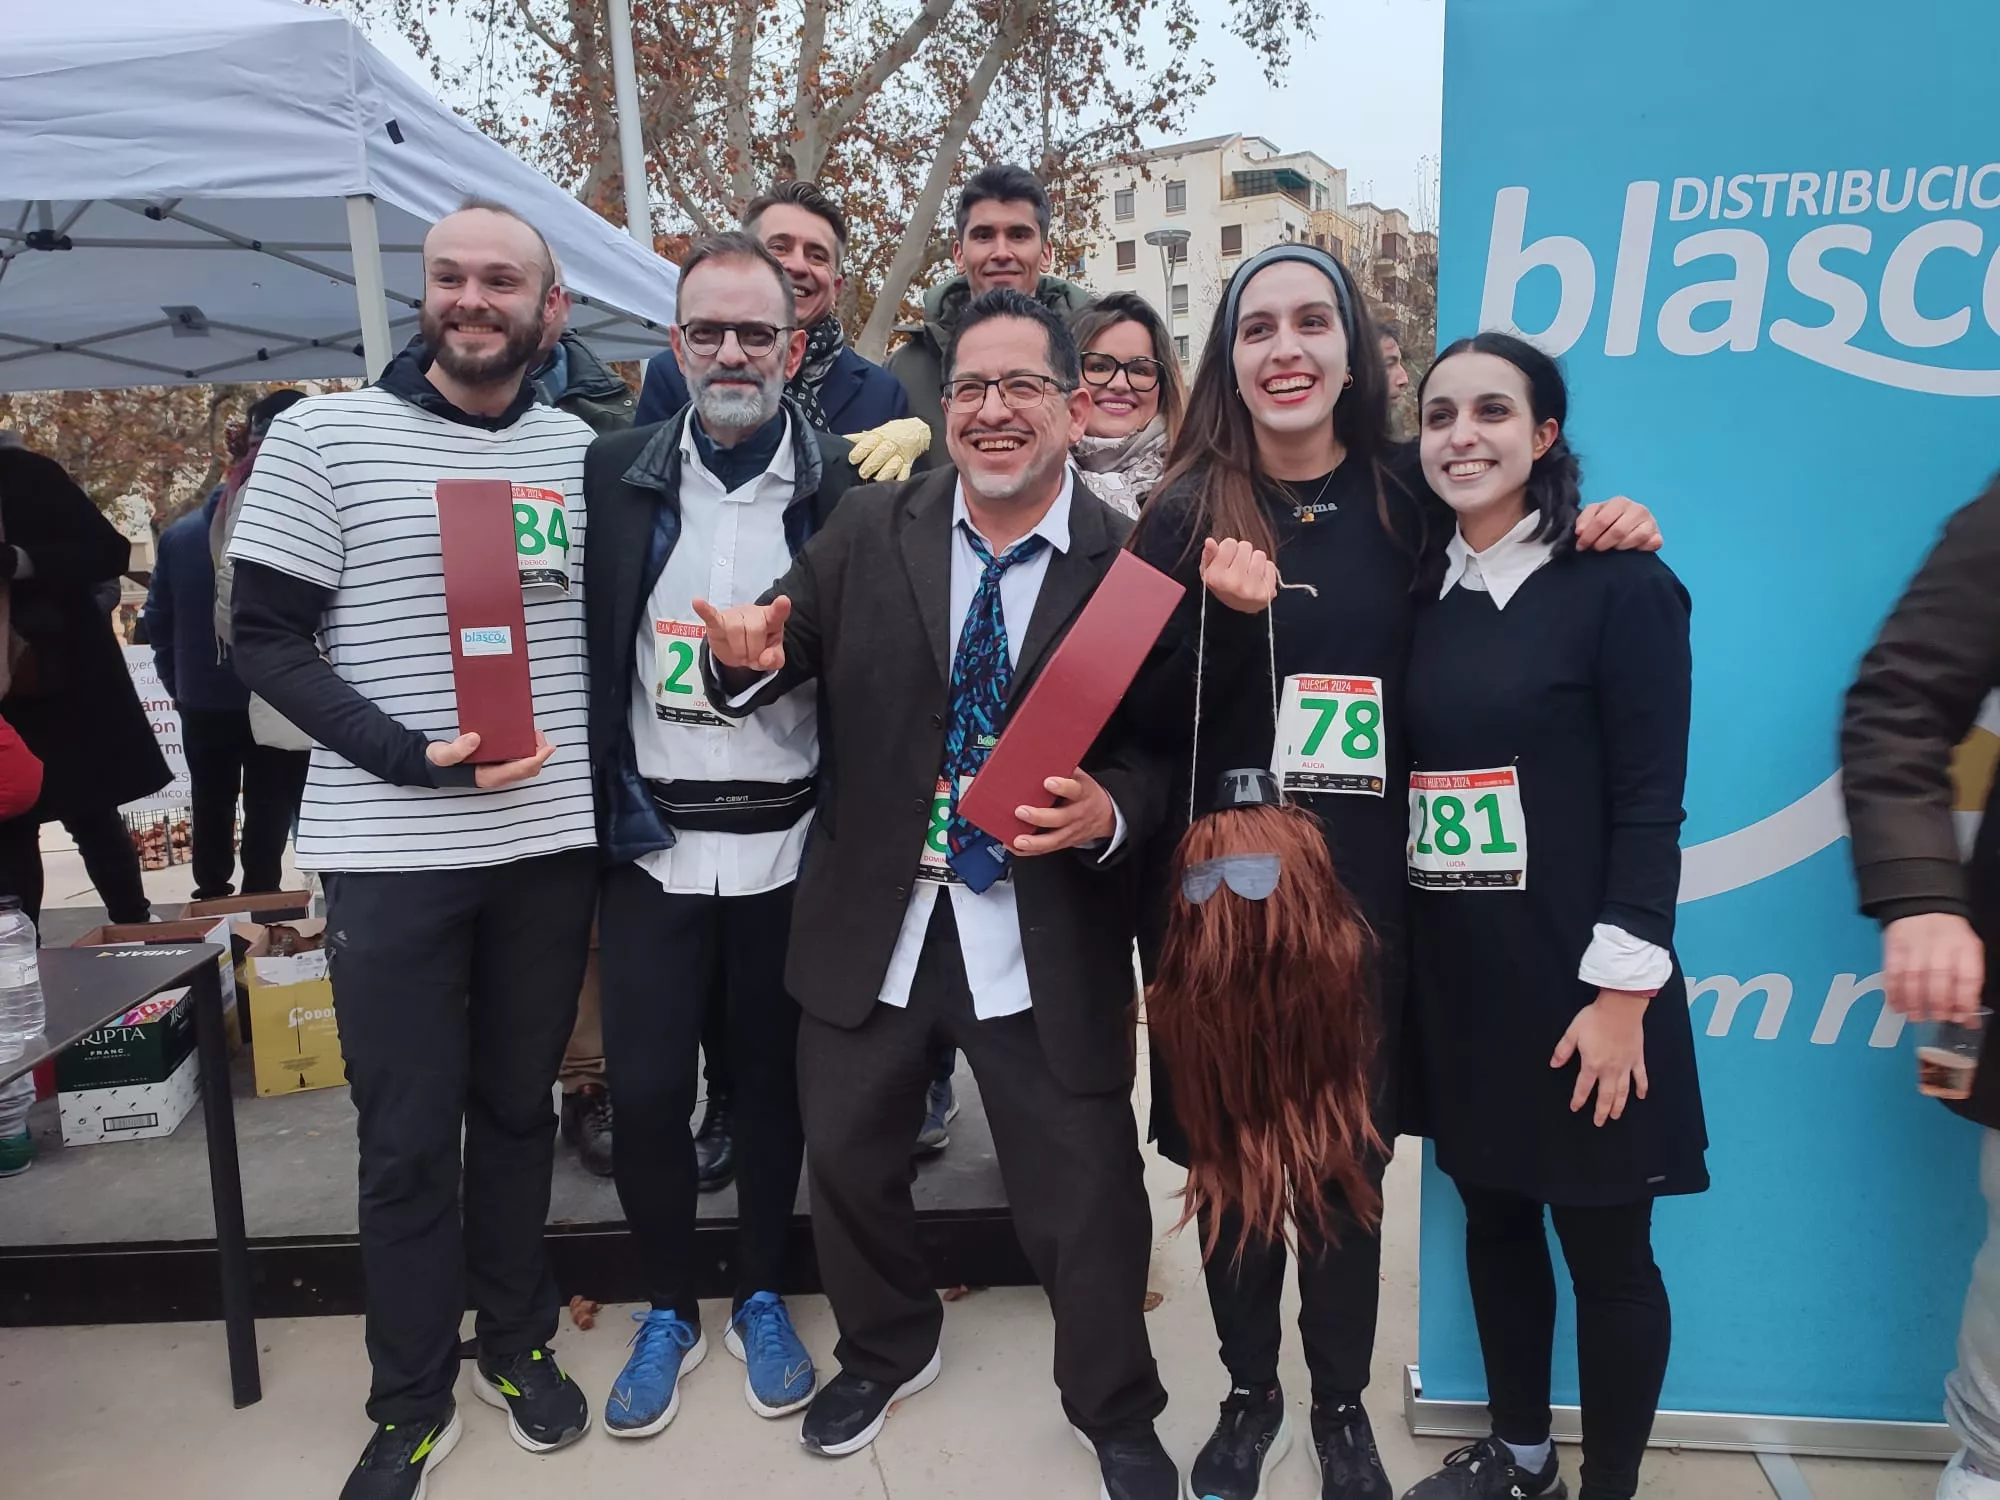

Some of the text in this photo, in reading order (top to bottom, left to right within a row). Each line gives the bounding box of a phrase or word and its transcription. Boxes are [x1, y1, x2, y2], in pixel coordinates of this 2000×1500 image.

[1477, 180, 2000, 358] blasc
[512, 503, 570, 559] 84
[464, 631, 502, 642] blasco
[664, 640, 694, 695] 2
[1300, 679, 1329, 691] HUESCA
[1331, 681, 1352, 692] 2024
[1287, 698, 1381, 759] 78
[1301, 761, 1325, 769] ALICIA
[1416, 793, 1518, 856] 281
[115, 949, 193, 957] AMBAR
[75, 1027, 147, 1046] RIPTA
[90, 1048, 124, 1056] FRANC
